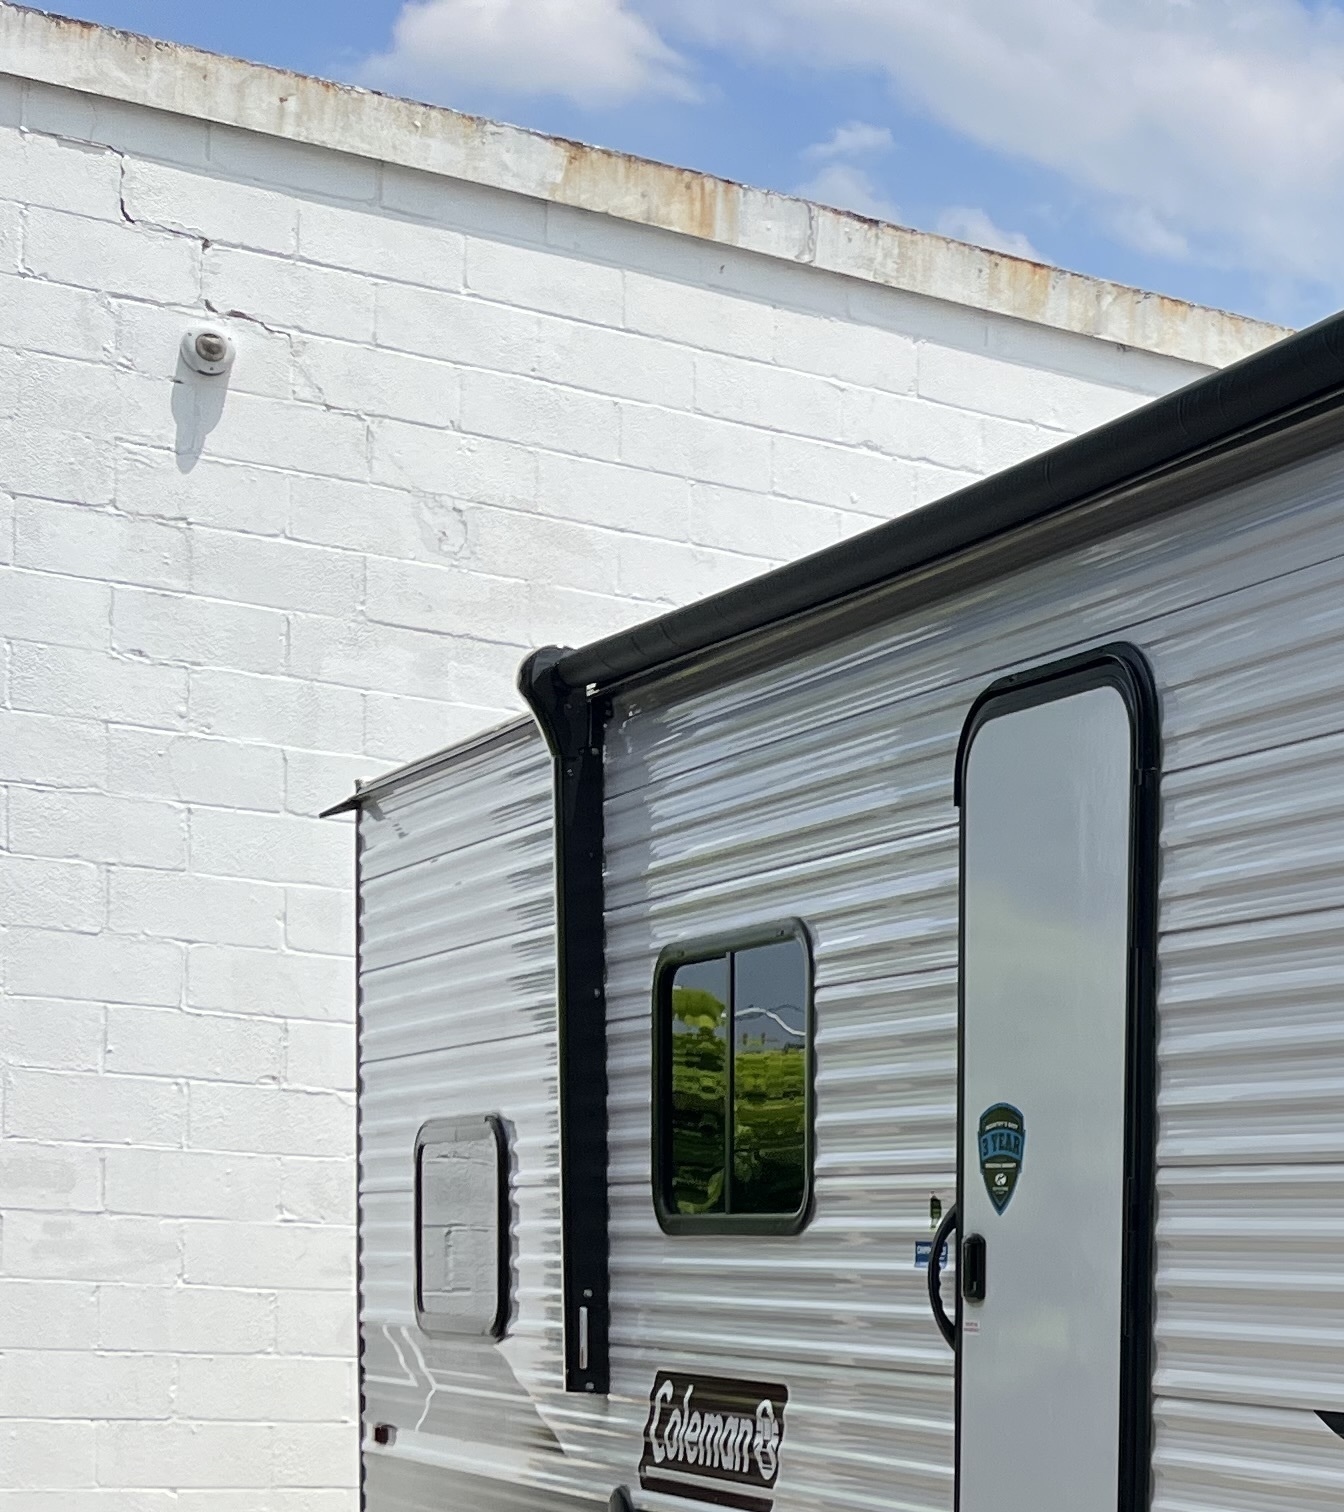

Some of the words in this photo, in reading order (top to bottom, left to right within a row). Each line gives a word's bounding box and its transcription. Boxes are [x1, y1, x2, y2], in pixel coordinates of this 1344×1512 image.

[982, 1137, 989, 1156] 3
[991, 1132, 1021, 1156] YEAR
[649, 1379, 754, 1473] Coleman
